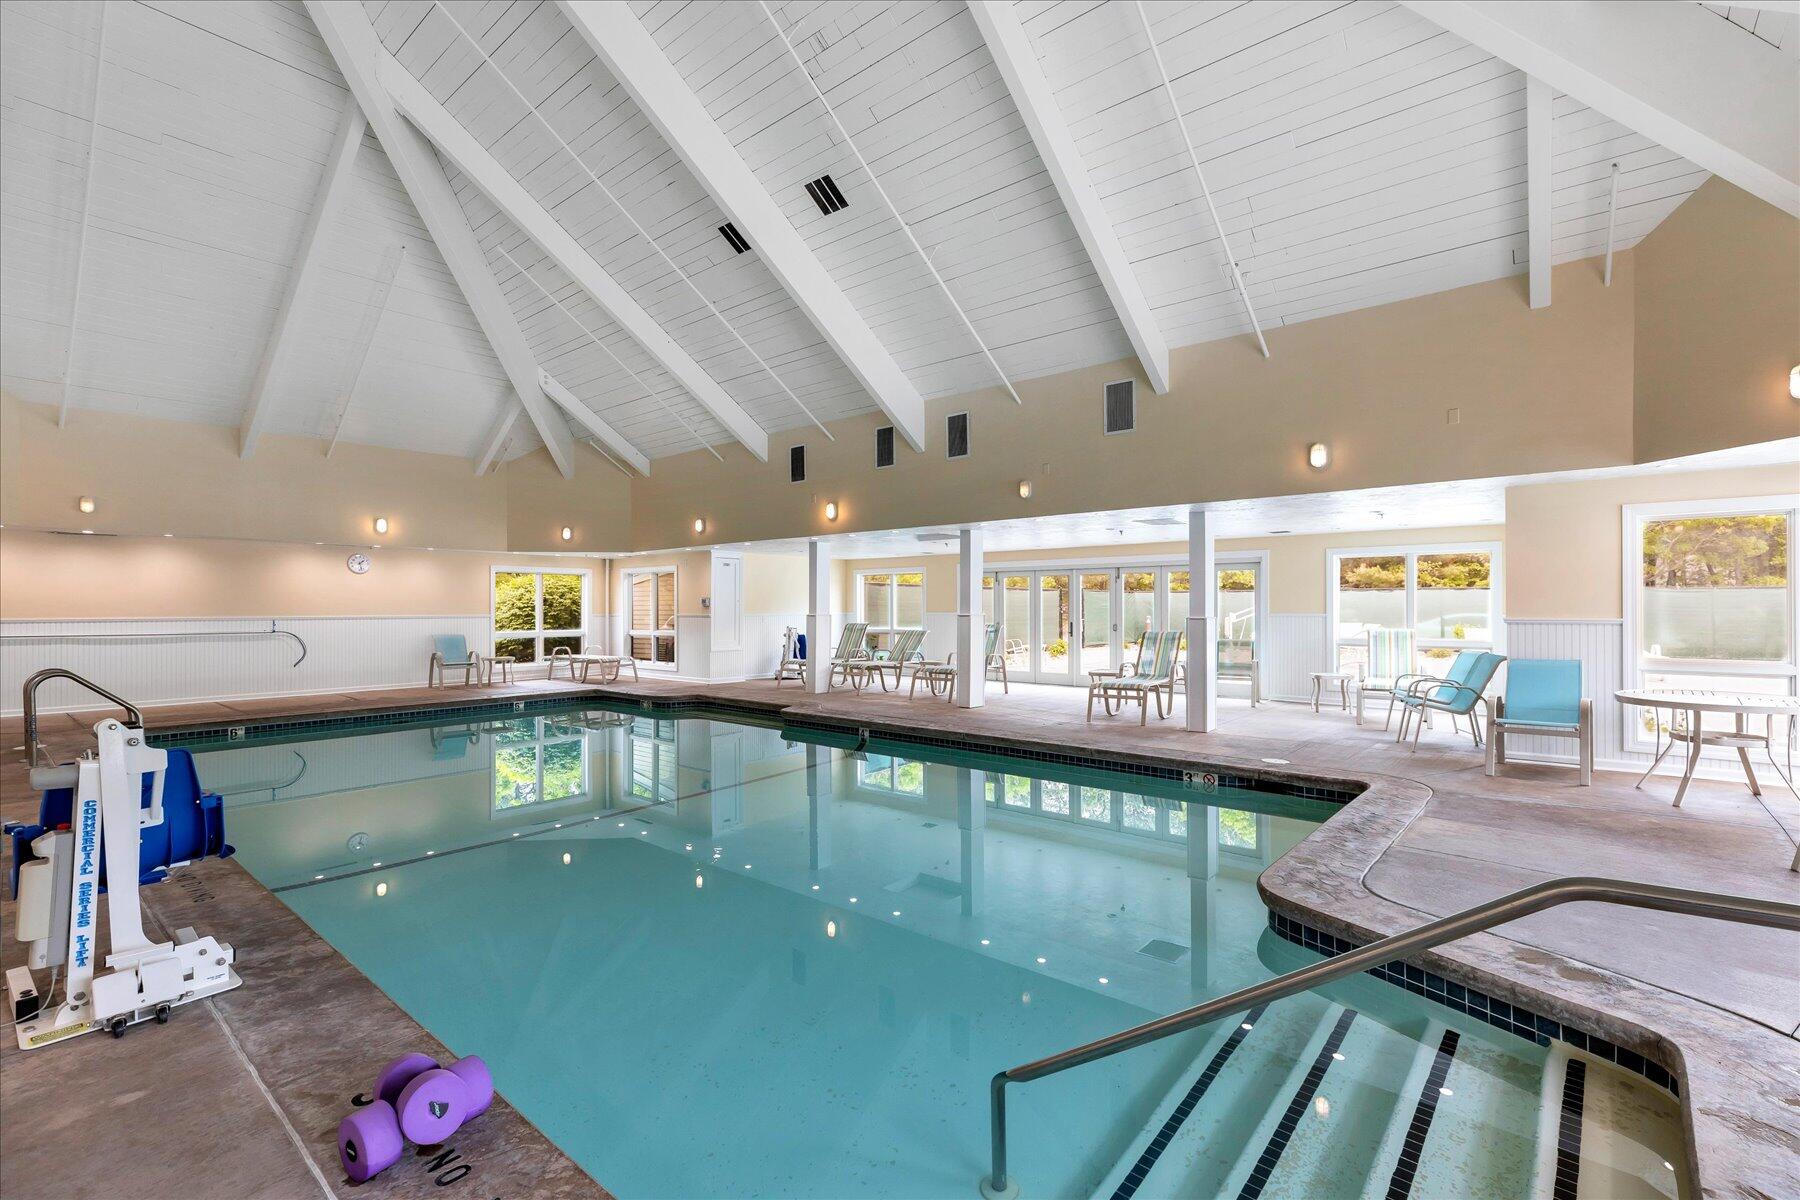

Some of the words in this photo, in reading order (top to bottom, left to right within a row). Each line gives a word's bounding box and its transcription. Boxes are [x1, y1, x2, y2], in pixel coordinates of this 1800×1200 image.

[81, 800, 97, 875] COMMERCIAL
[77, 882, 92, 928] SERIES
[76, 935, 89, 968] LIFT
[422, 1149, 472, 1187] NO
